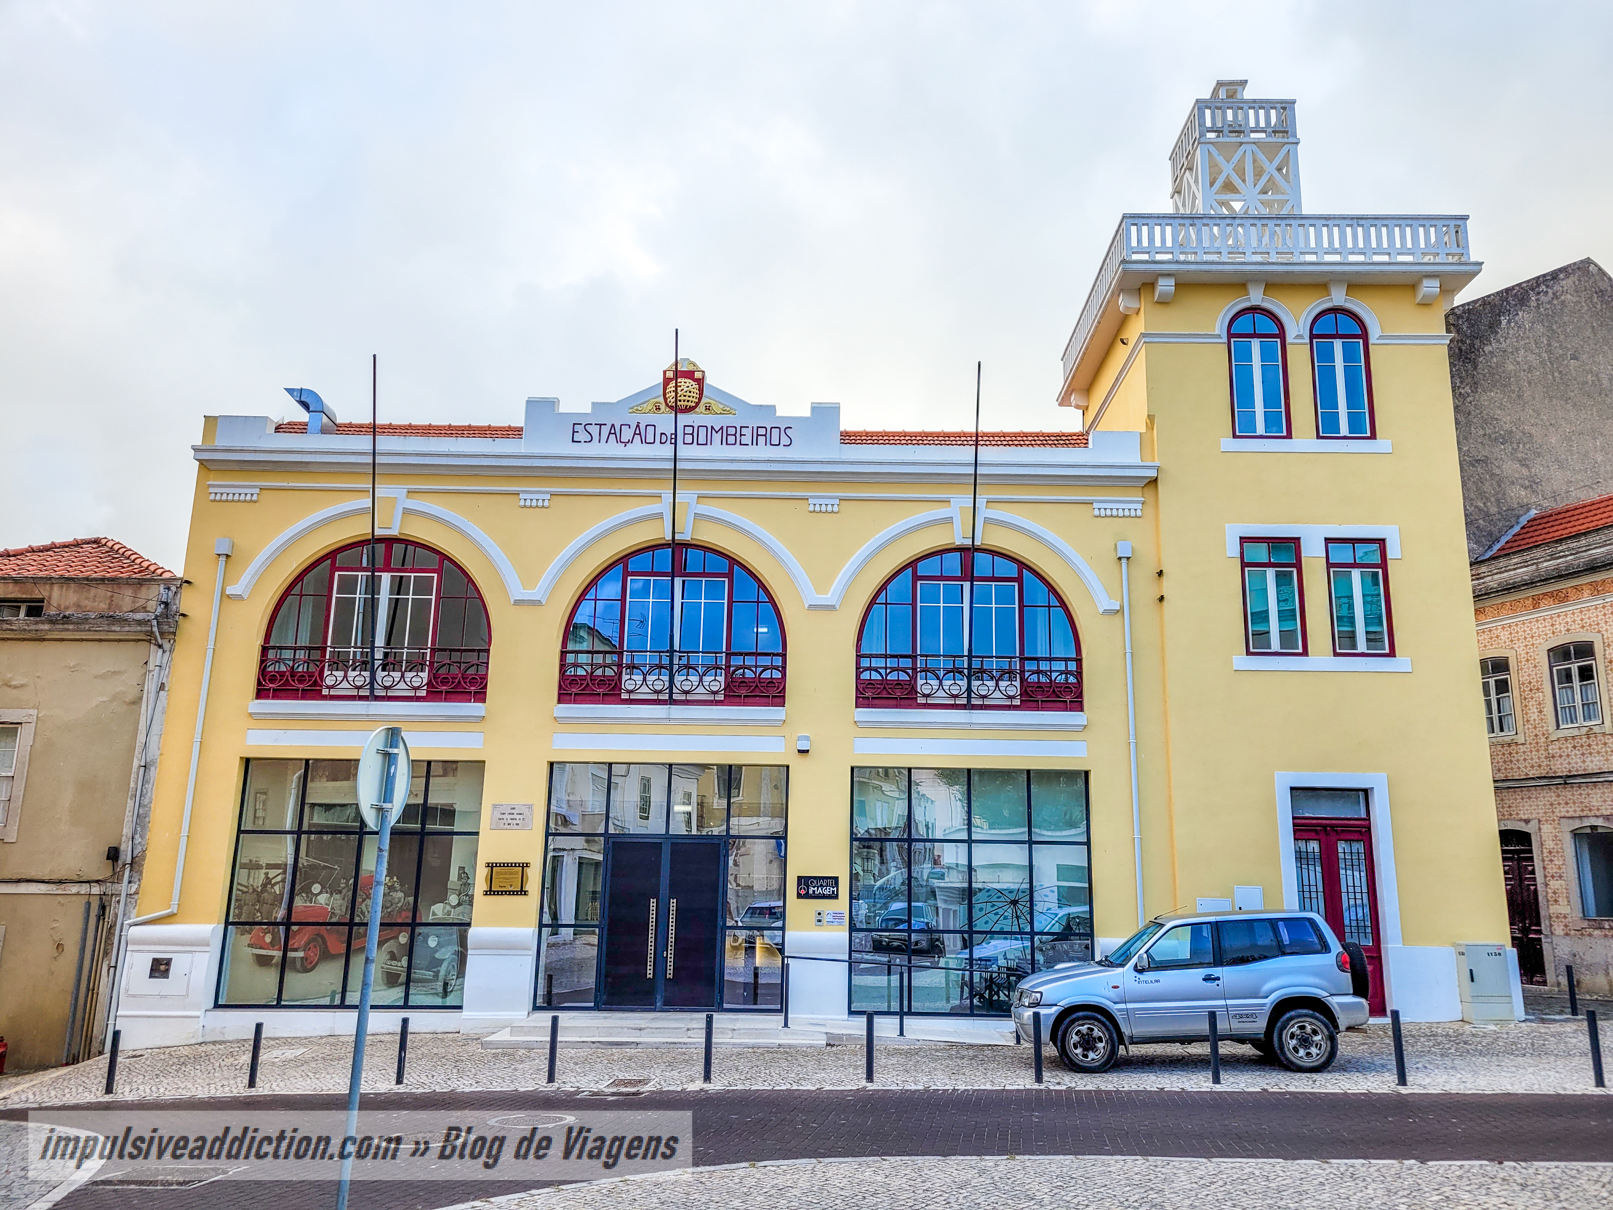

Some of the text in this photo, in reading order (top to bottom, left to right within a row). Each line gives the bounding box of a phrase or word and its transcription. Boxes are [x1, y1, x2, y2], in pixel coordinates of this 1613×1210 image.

[571, 421, 793, 447] ESTAÇÃO DE BOMBEIROS
[809, 879, 835, 887] QUARTEL
